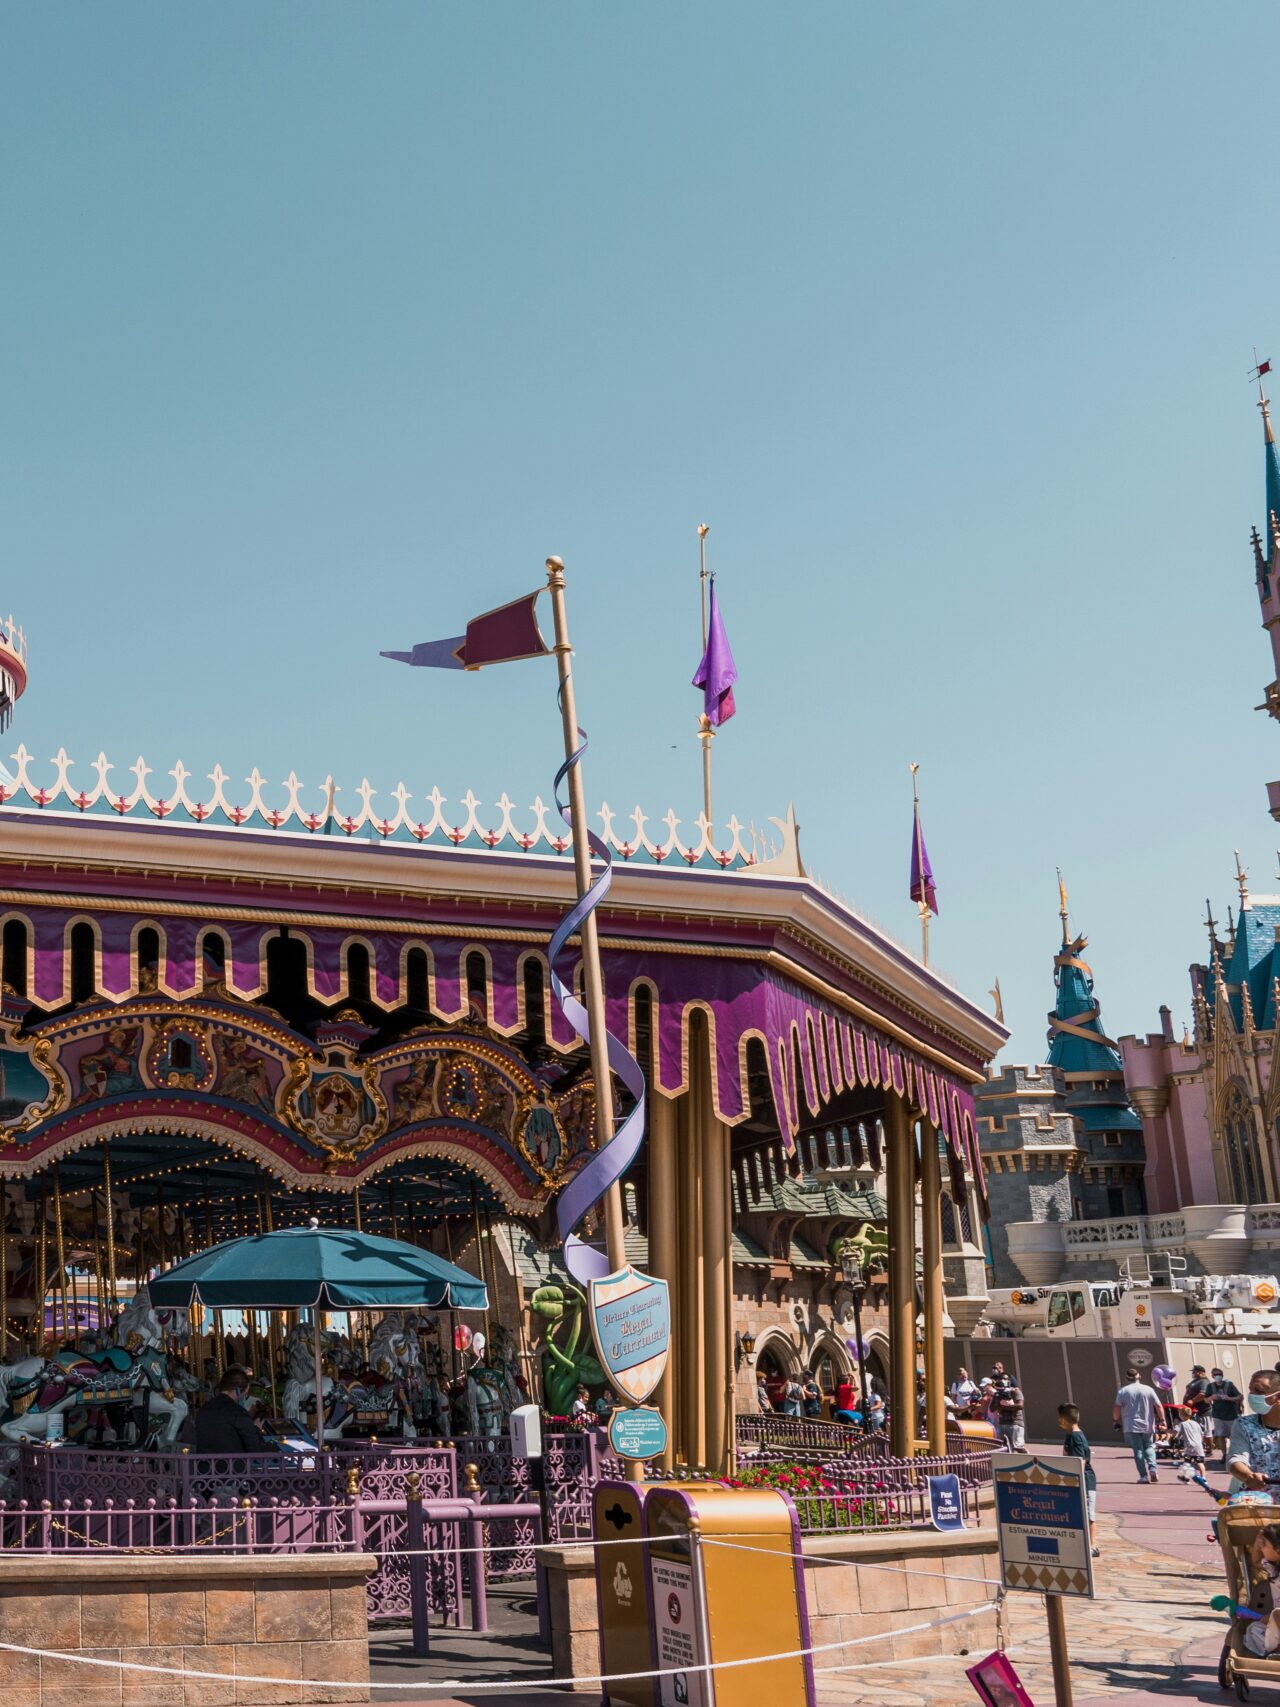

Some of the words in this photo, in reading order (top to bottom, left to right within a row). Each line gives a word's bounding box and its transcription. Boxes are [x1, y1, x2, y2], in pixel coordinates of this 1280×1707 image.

[603, 1310, 629, 1328] Prince
[620, 1311, 652, 1338] Regal
[609, 1322, 666, 1360] Carrousel
[1008, 1486, 1031, 1496] Prince
[1022, 1496, 1056, 1511] Regal
[1011, 1508, 1070, 1523] Carrousel
[1008, 1526, 1047, 1536] ESTIMATED
[1048, 1530, 1067, 1538] WAIT
[1028, 1554, 1061, 1563] MINUTES
